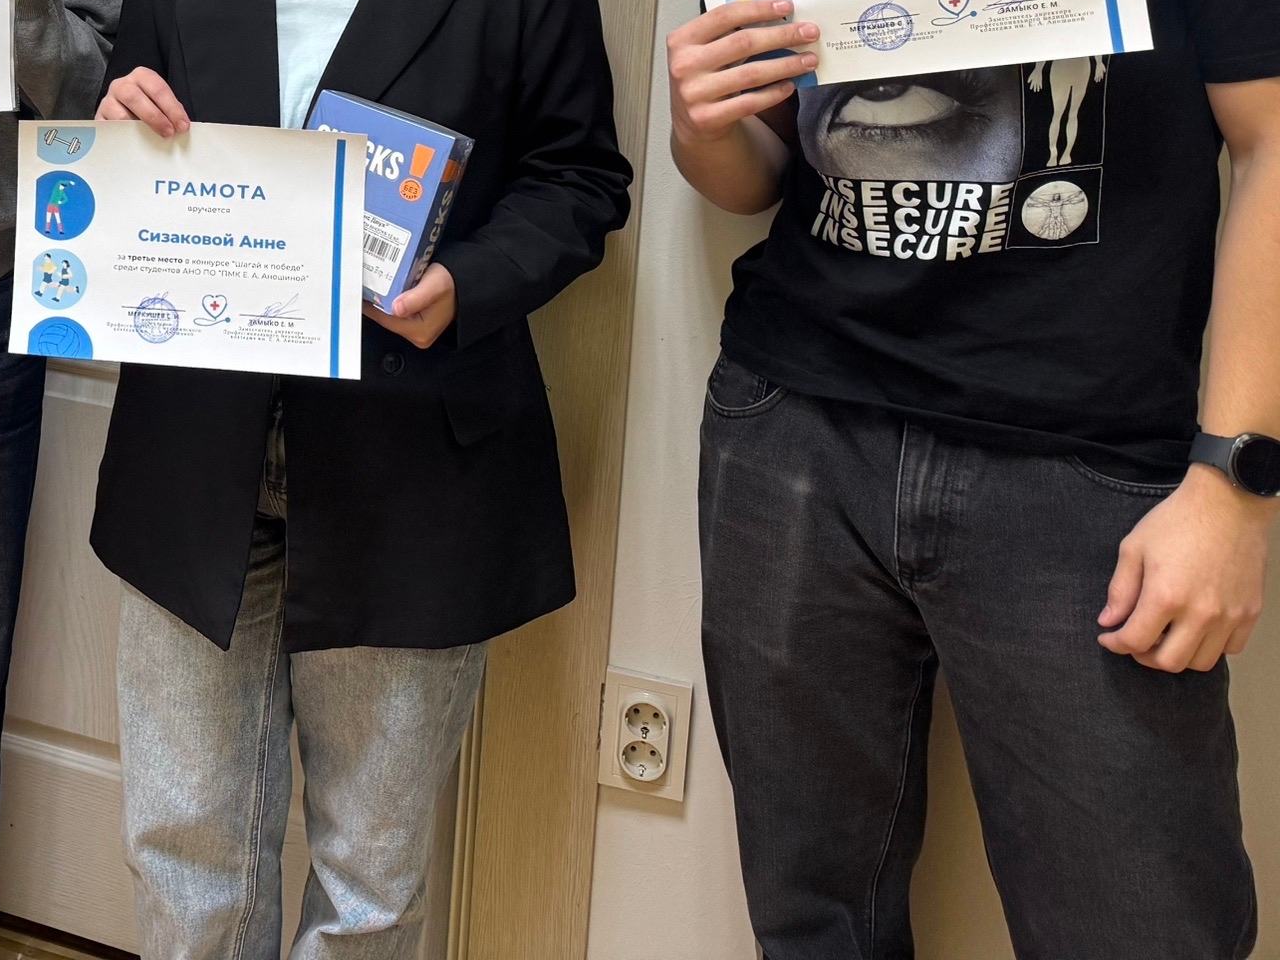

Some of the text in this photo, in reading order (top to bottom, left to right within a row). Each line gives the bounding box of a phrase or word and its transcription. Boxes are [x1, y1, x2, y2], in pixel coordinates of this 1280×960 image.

[155, 180, 265, 200] ГРАМОТА
[188, 205, 230, 214] вручается
[820, 190, 1009, 236] INSECURE
[138, 229, 286, 250] Сизаковой Анне
[811, 212, 1006, 262] INSECURE
[114, 264, 309, 281] среди студентов АНО ПО "ПМК Е. А. Аношиной"
[128, 254, 155, 262] третье
[158, 256, 183, 264] место
[192, 259, 229, 267] конкурсе
[232, 260, 261, 268] "Шагай
[271, 262, 304, 271] победе"
